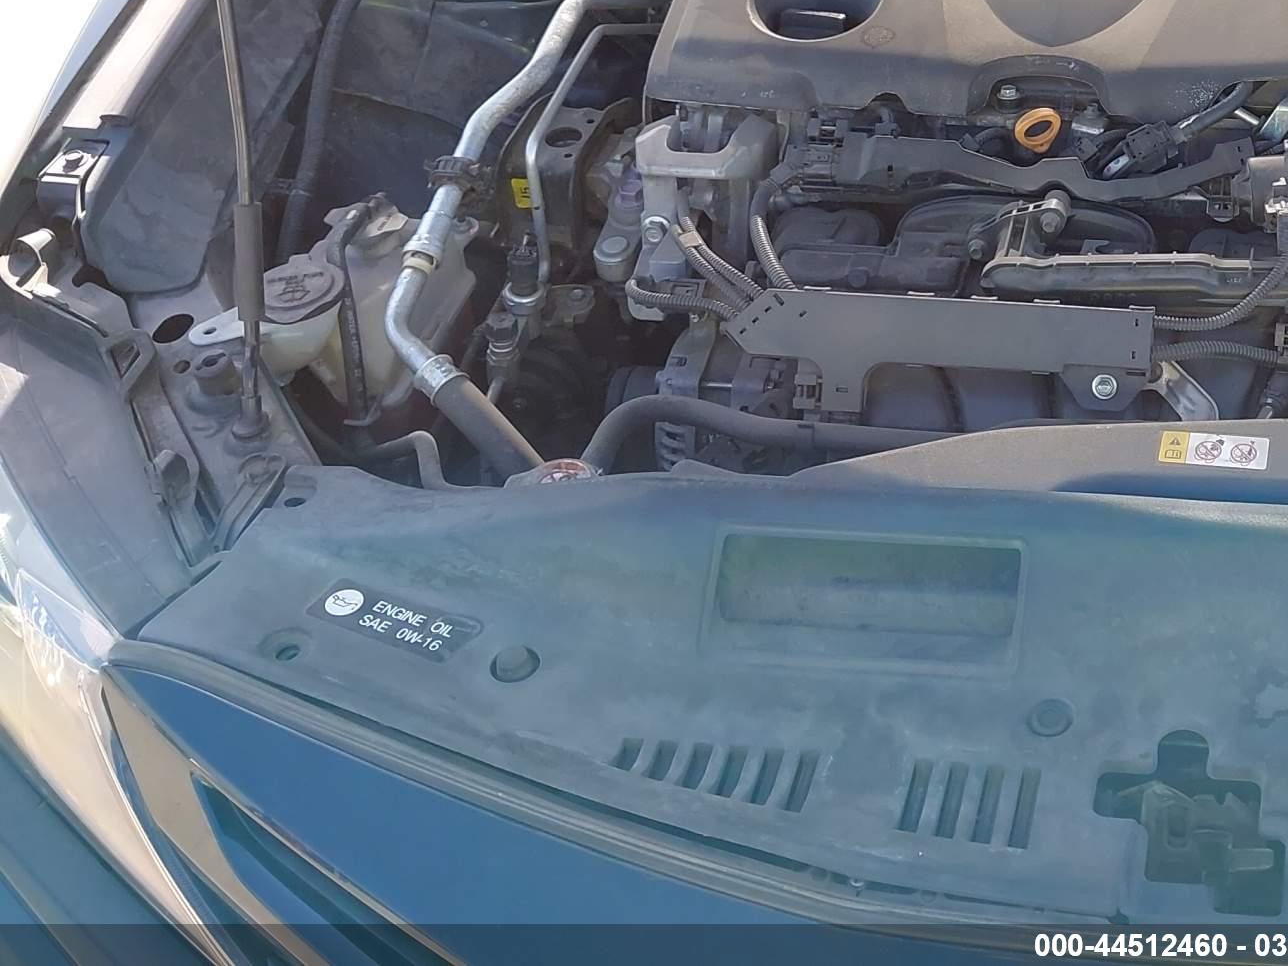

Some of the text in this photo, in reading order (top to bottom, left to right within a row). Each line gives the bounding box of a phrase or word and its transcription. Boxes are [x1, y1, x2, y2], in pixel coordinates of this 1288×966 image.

[358, 614, 443, 651] SAE 0W-16
[372, 600, 453, 638] ENGINE OIL
